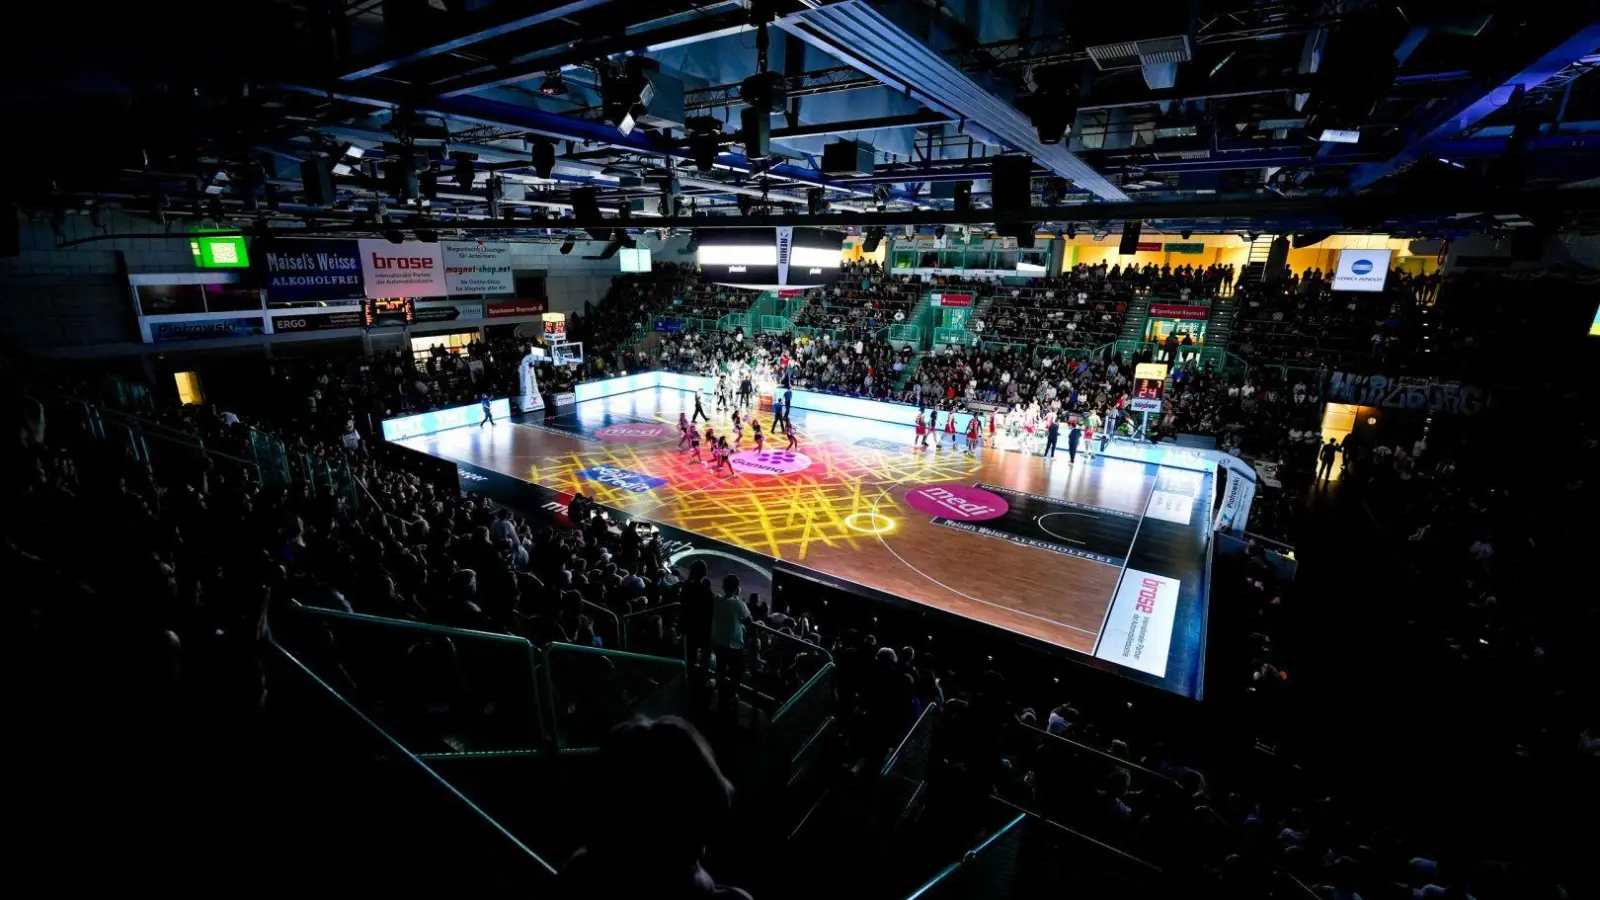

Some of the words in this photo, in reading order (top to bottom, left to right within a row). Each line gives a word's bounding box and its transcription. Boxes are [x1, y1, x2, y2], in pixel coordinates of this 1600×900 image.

[780, 238, 788, 264] REHAU
[266, 253, 315, 272] Maisel's
[316, 254, 356, 271] Weisse
[372, 252, 434, 269] brose
[445, 265, 510, 275] magnet-shop.net
[272, 275, 359, 286] ALKOHOLFREI
[488, 307, 515, 315] Sparkasse
[1182, 309, 1206, 317] Bayreuth
[157, 322, 236, 337] Piotrowski
[277, 319, 306, 329] ERGO
[1139, 388, 1157, 398] 24
[604, 427, 663, 437] medi
[1226, 477, 1240, 508] Piotrowski
[926, 486, 996, 518] medi
[944, 519, 977, 534] Maisel's
[978, 526, 1009, 540] Weisse
[1009, 536, 1111, 563] ALKOHOLFREI
[1135, 577, 1166, 614] brose
